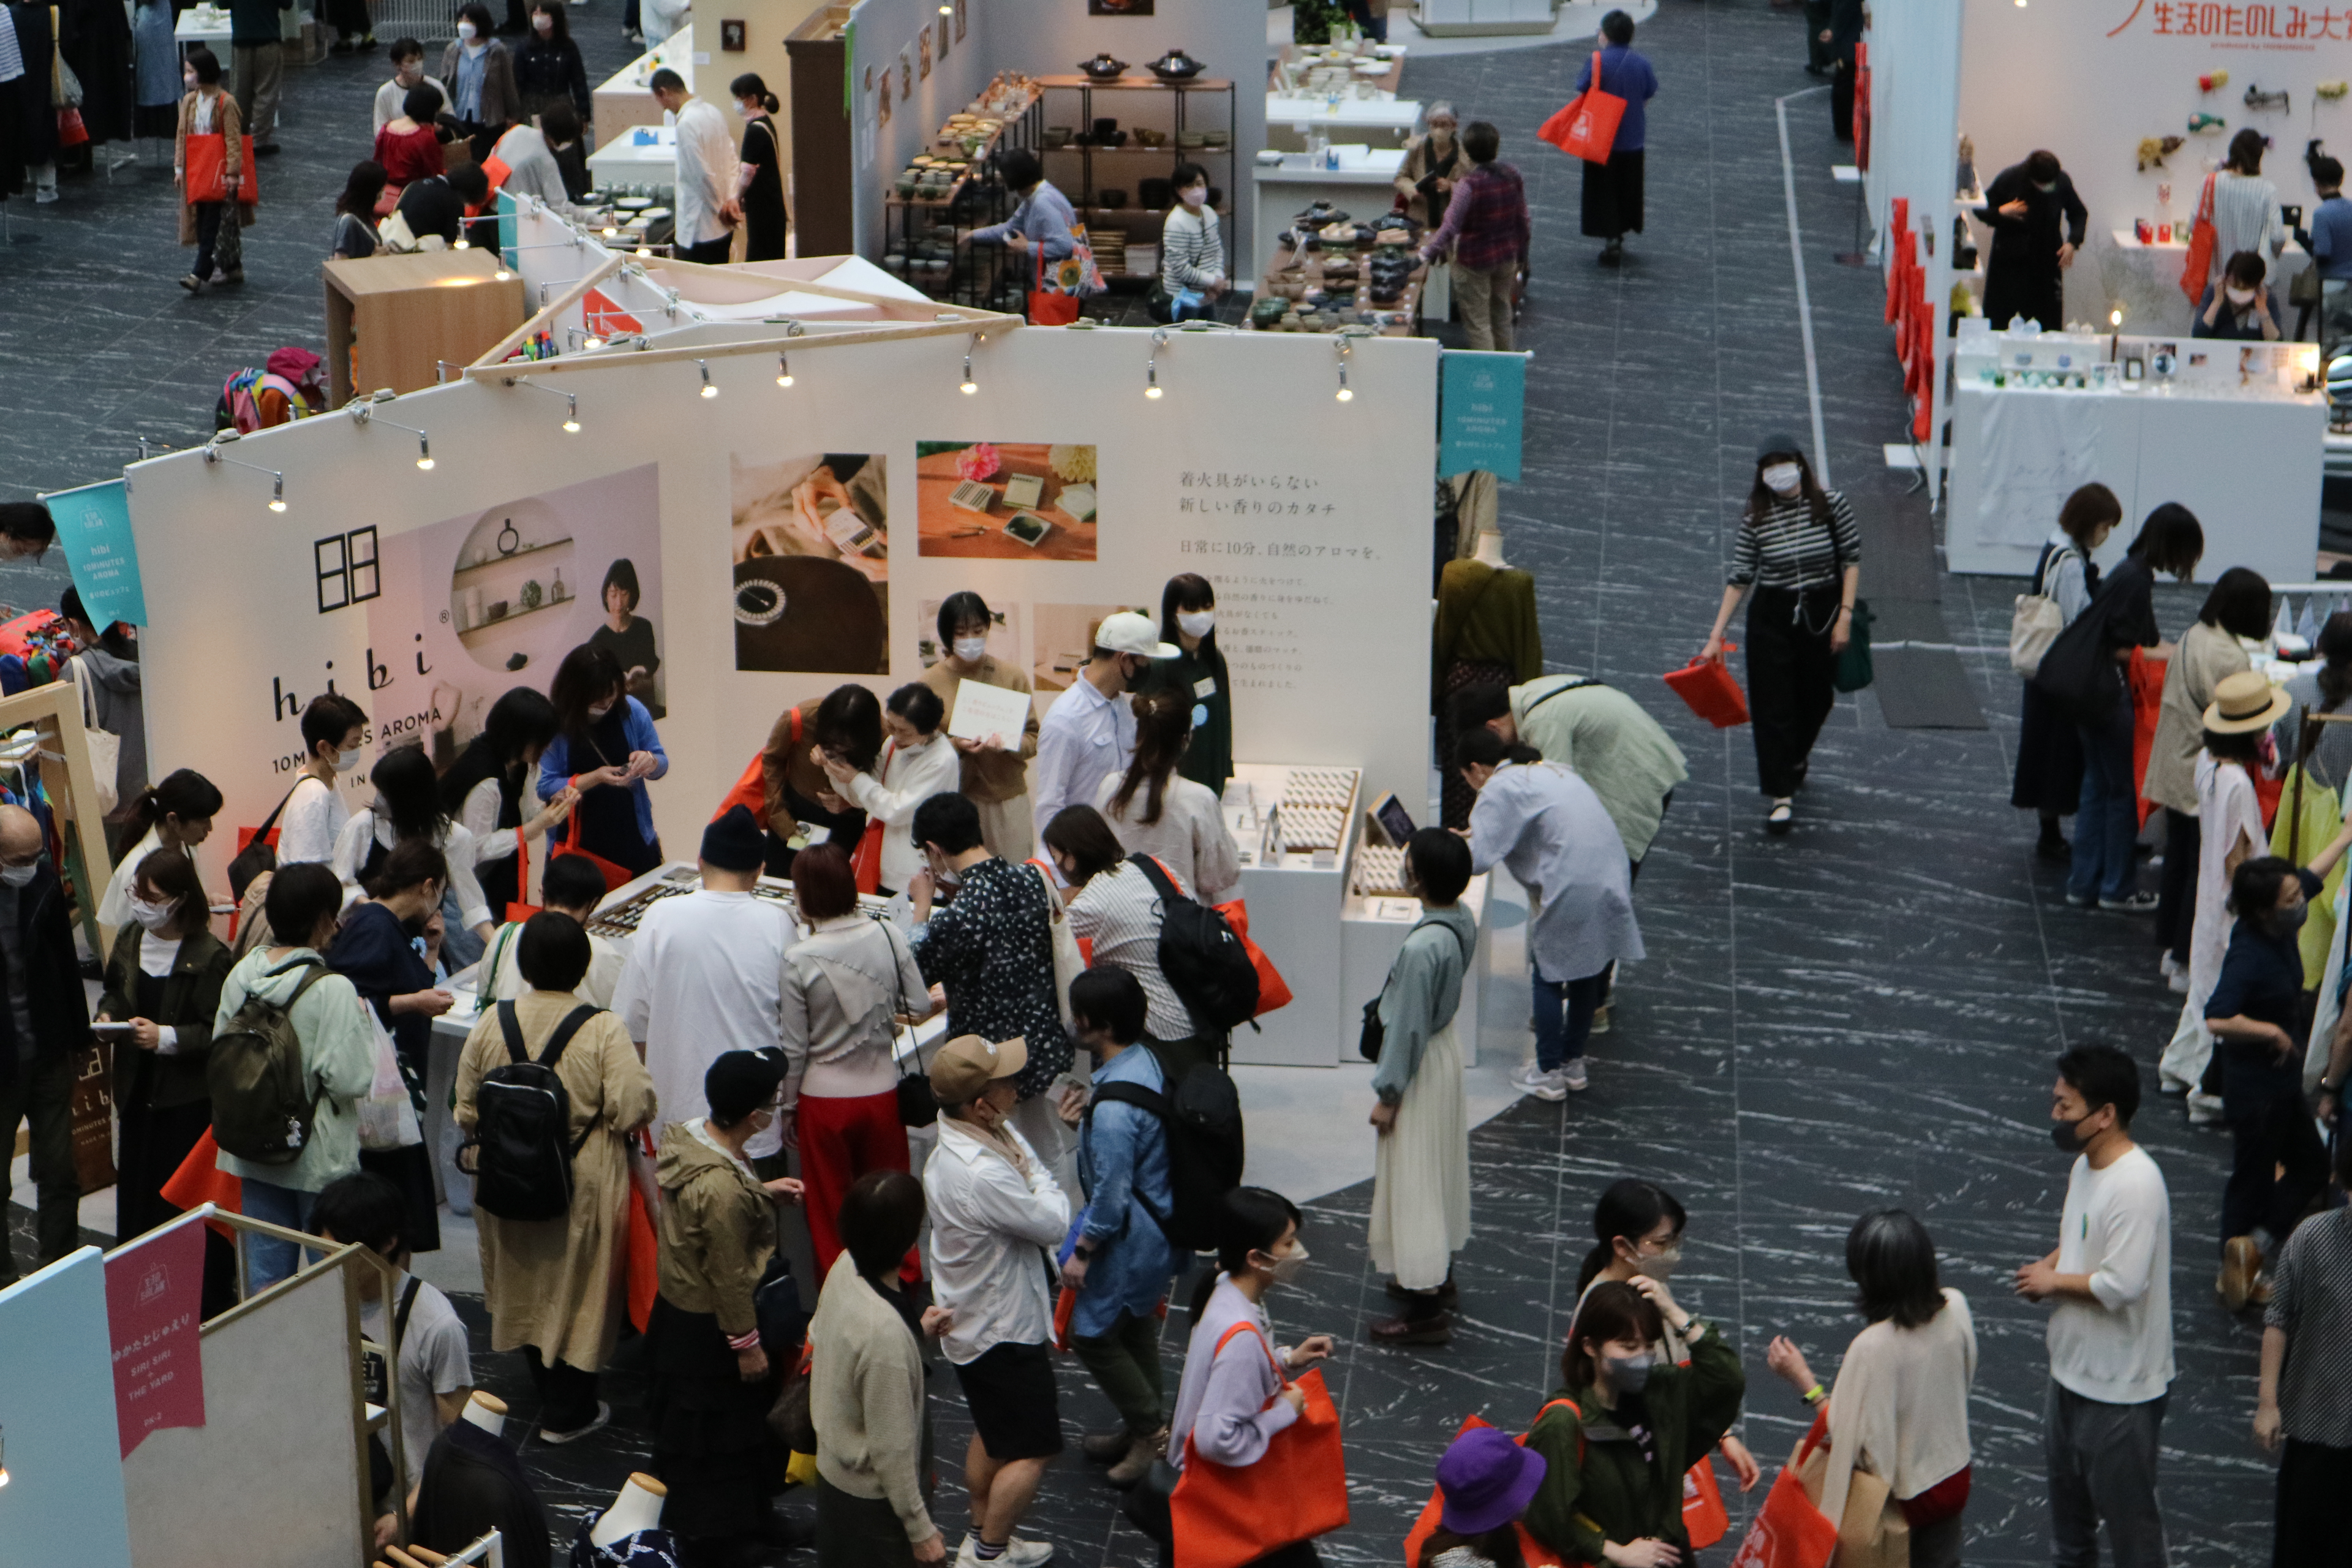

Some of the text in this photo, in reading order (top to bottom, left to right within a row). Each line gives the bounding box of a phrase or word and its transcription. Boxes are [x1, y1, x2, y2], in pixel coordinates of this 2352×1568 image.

[2153, 2, 2352, 40] 生活のたのしみ大
[1180, 470, 1319, 490] 着火具がいらない
[1180, 497, 1336, 515] 新しい香りのカタチ
[91, 543, 110, 556] hibi
[83, 557, 125, 571] 10MINUTES
[92, 569, 119, 581] AROMA
[381, 707, 442, 740] AROMA
[350, 774, 366, 788] IN
[130, 1349, 172, 1377] SIRI SIRI
[127, 1371, 174, 1401] THE YARD
